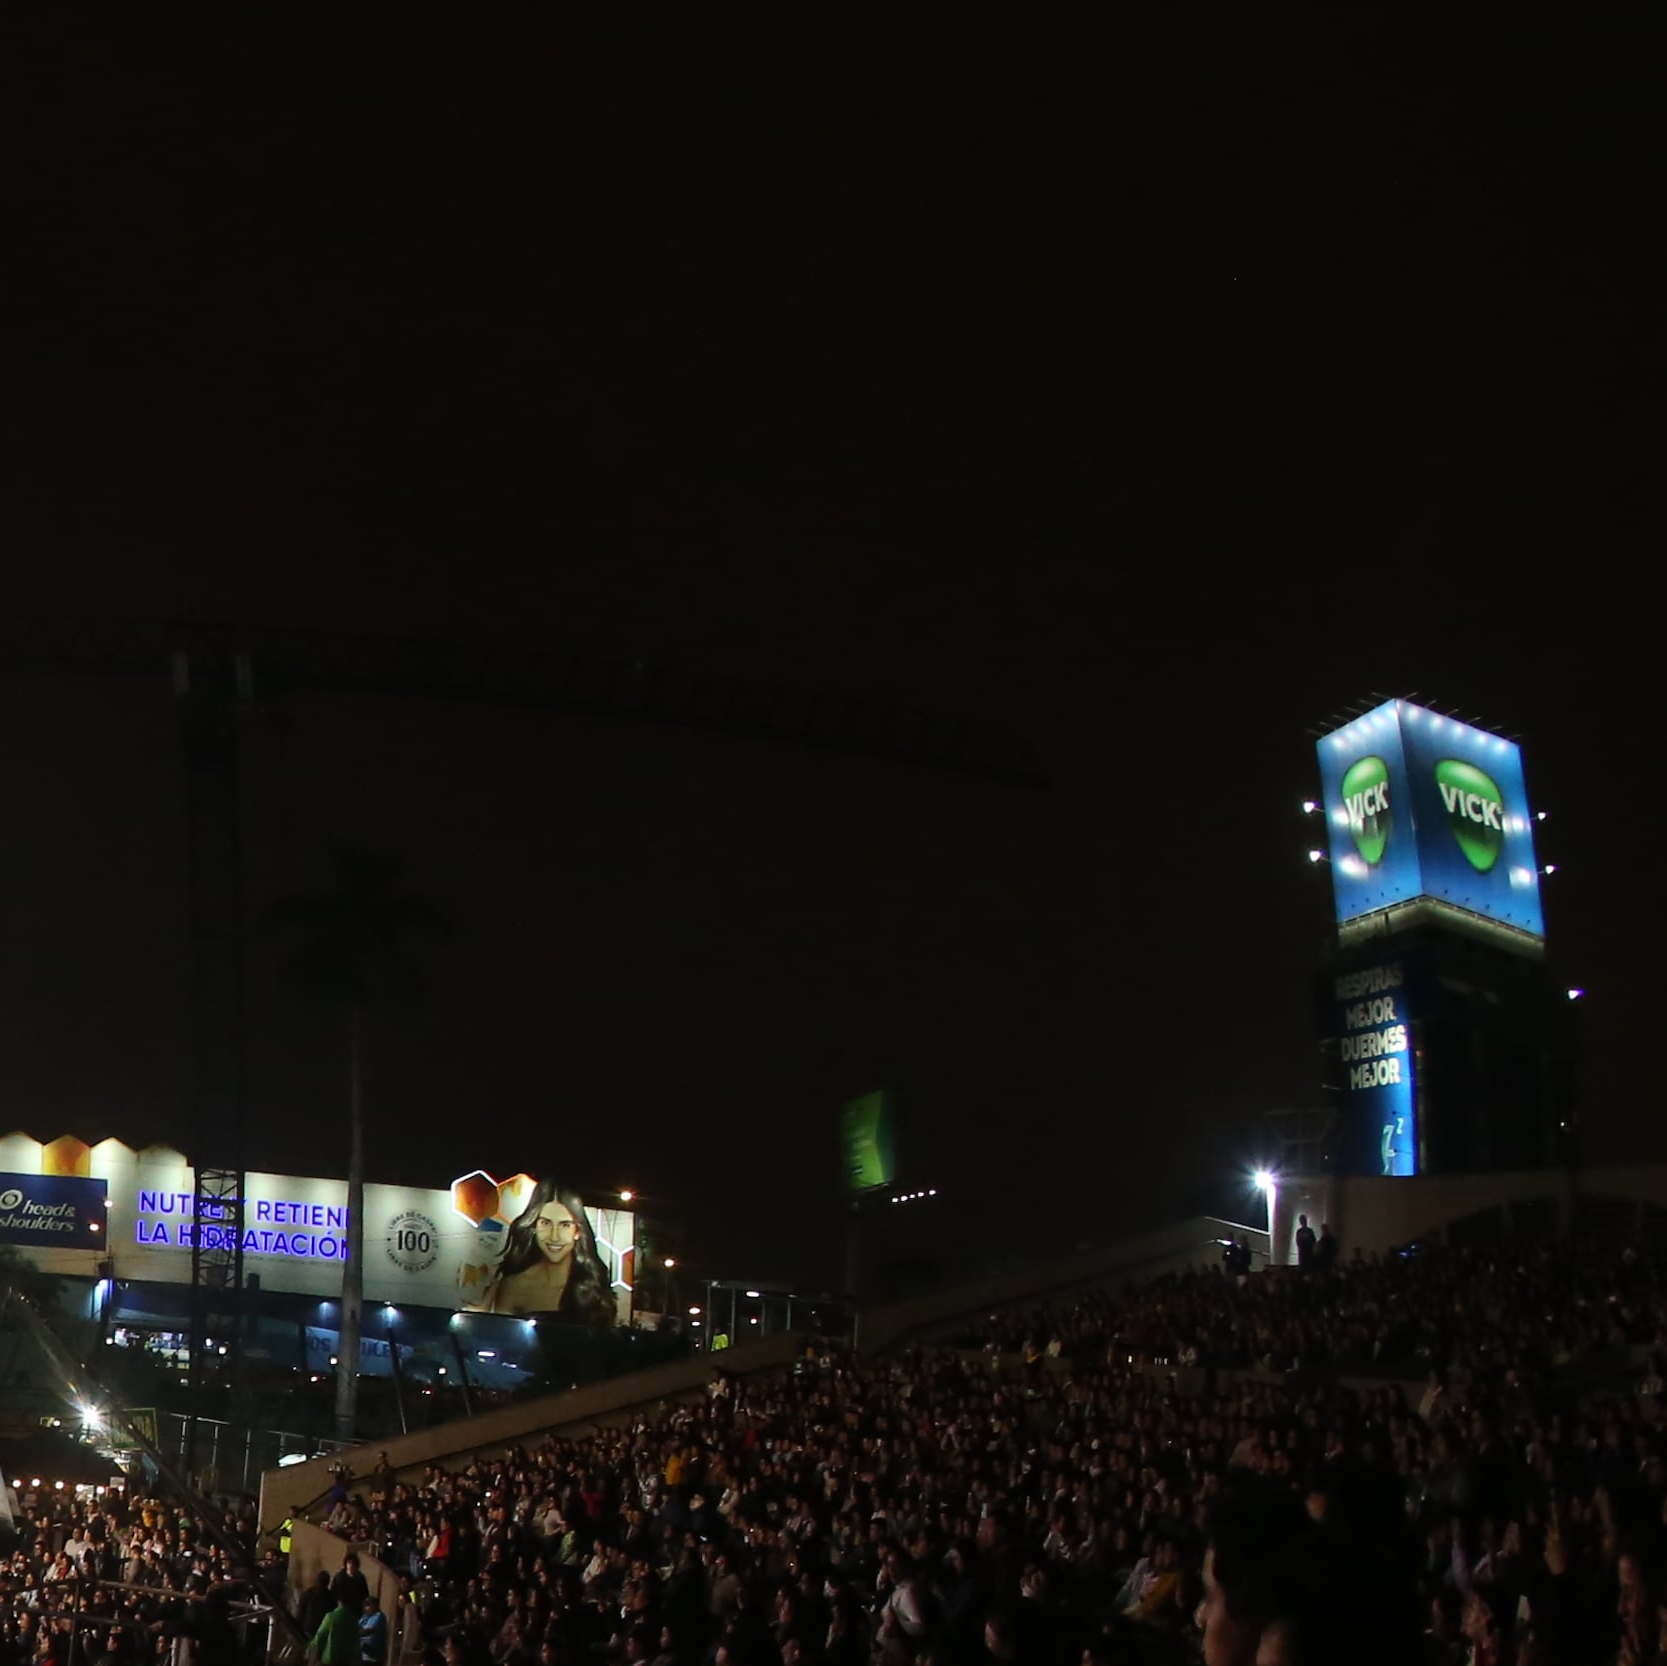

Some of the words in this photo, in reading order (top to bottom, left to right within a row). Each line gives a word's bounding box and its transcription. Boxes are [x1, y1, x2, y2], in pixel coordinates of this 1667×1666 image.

[1345, 781, 1389, 823] VICK
[1438, 782, 1501, 831] VICK
[1341, 1025, 1407, 1061] DUERMES
[1350, 1057, 1401, 1091] MEJOR
[256, 1199, 349, 1230] RETIEN
[136, 1220, 170, 1245] LA
[397, 1230, 430, 1253] 100
